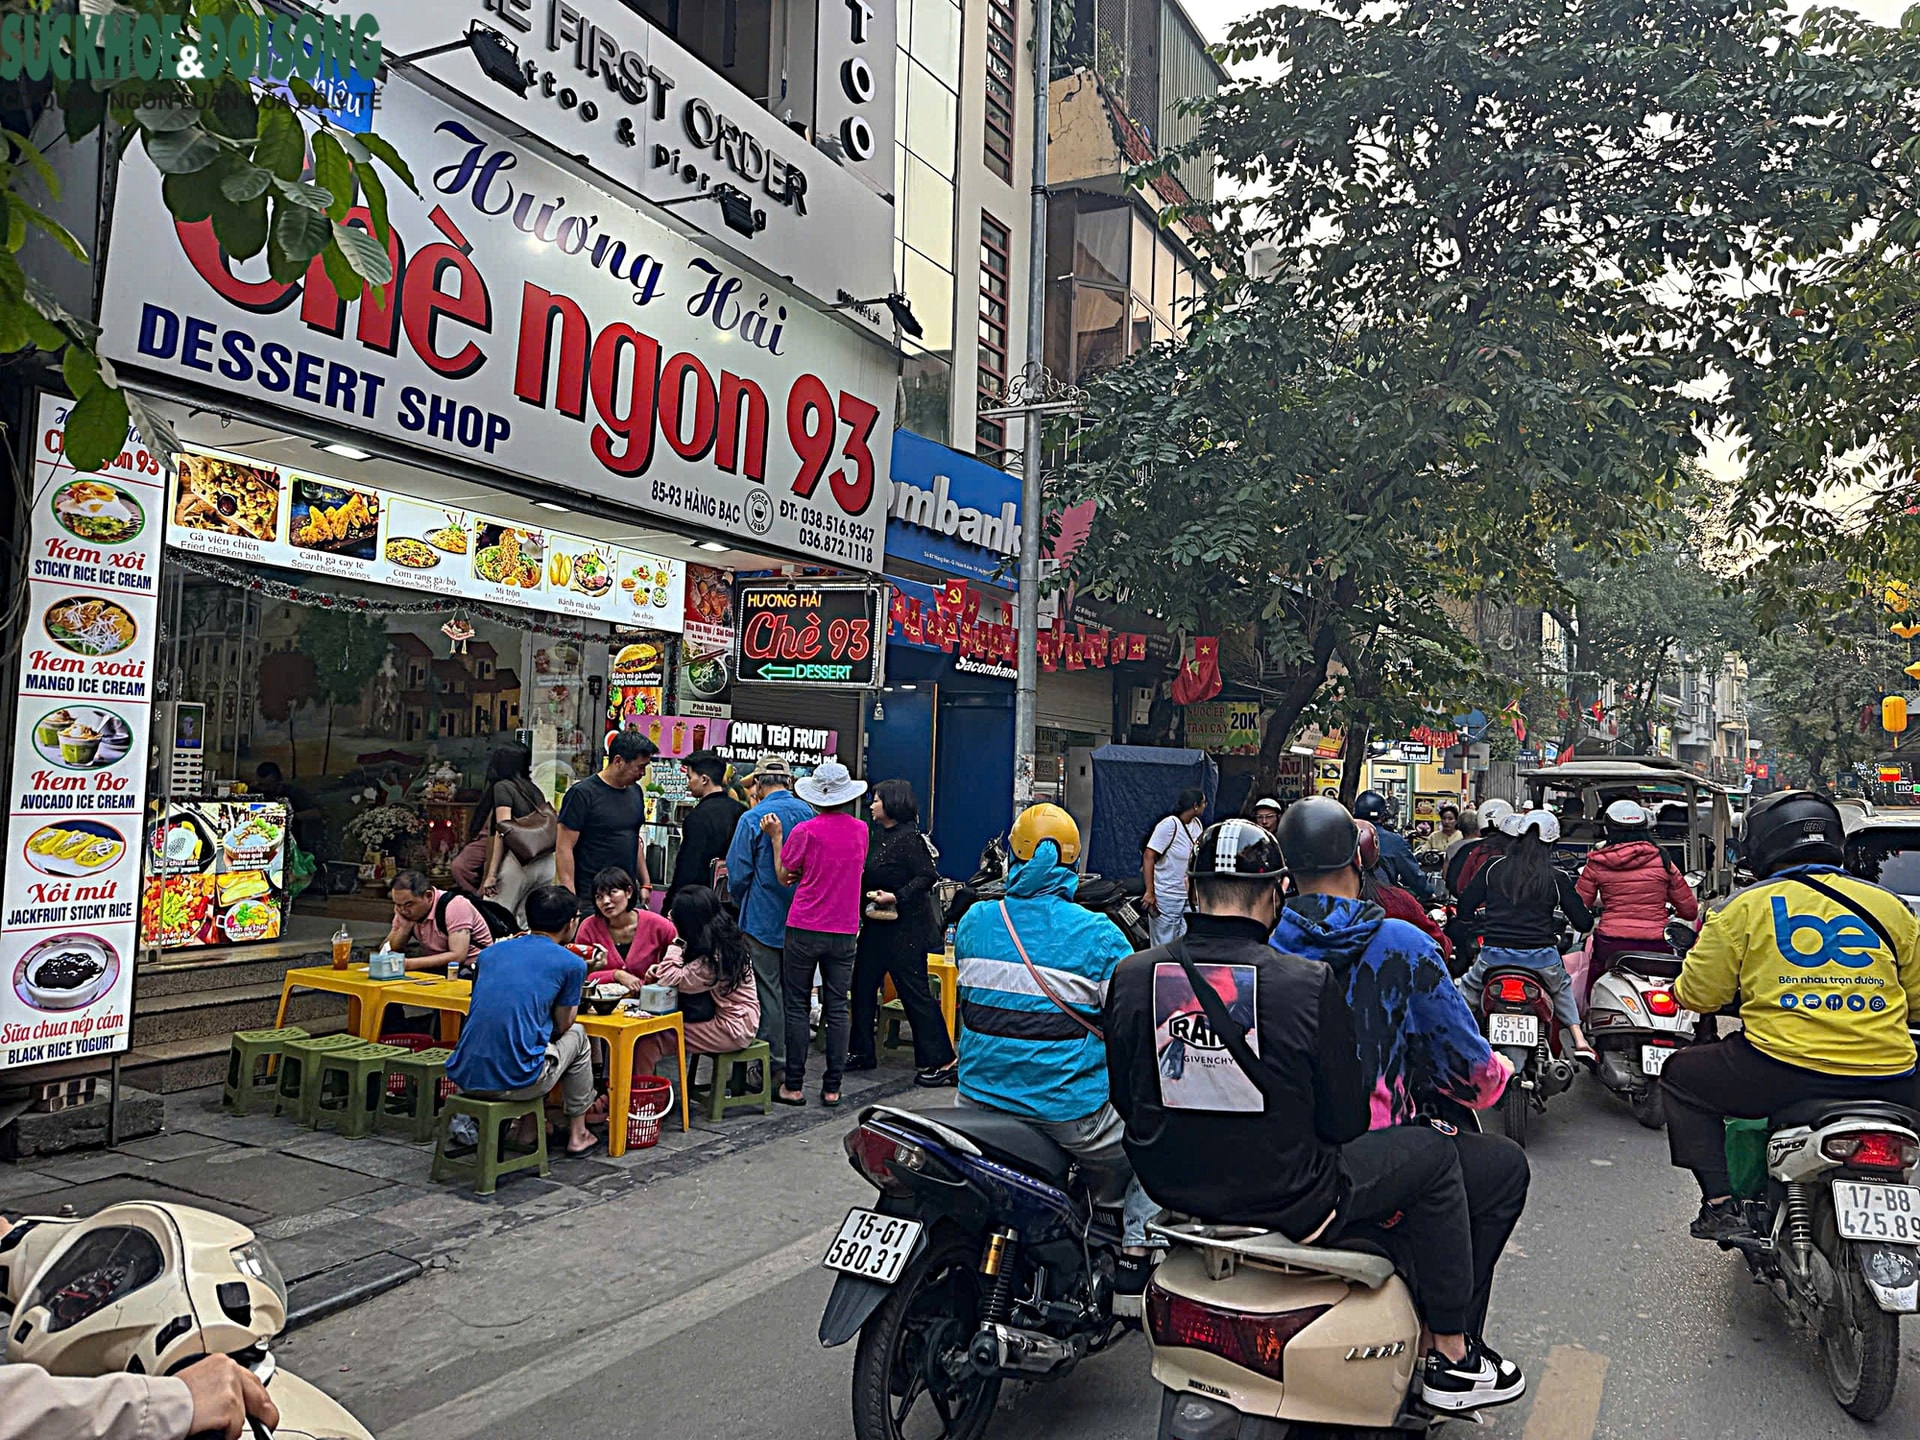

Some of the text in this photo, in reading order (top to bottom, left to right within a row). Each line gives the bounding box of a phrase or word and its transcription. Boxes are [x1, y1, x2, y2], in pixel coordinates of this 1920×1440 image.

[525, 60, 599, 123] ttoo
[617, 117, 637, 148] &
[549, 0, 675, 120] FIRST
[684, 98, 808, 216] ORDER
[433, 120, 785, 356] Hương Hải
[137, 302, 511, 454] DESSERT SHOP
[514, 280, 770, 479] ngon
[786, 373, 881, 516] 93
[652, 479, 742, 528] 85-93 HÀNG BẠC
[780, 499, 876, 545] ĐT: 038.516.9347
[45, 537, 146, 571] Kem xôi
[207, 546, 243, 558] chicken
[245, 552, 266, 562] balls
[799, 528, 874, 565] 036.872.1118
[35, 559, 152, 590] STICKY RICE ICE CREAM
[291, 559, 314, 570] Spicy
[315, 565, 347, 576] chicken
[747, 590, 822, 608] HƯƠNG HẢI
[744, 611, 870, 661] Chè 93
[30, 650, 146, 679] Kem xoài
[795, 663, 853, 680] DESSERT
[26, 674, 146, 697] MANGO ICE CREAM
[1230, 711, 1258, 730] 20K
[731, 722, 828, 750] ANN TEA FRUIT
[716, 745, 734, 760] TRÀ
[736, 746, 756, 761] TRÁI
[31, 770, 86, 791] Kem
[20, 794, 135, 810] AVOCADO ICE CREAM
[27, 879, 118, 904] Xôi mít
[7, 902, 132, 926] JACKFRUIT STICKY RICE
[1770, 896, 1881, 968] be
[1778, 976, 1885, 988] Bên nhau trọn đường
[0, 1005, 124, 1045] Sữa chua nếp cẩm
[1496, 1015, 1530, 1030] 95-E1
[8, 1034, 116, 1065] BLACK RICE YOGURT
[1493, 1030, 1534, 1044] 461.00
[1183, 1055, 1234, 1065] GIVENCHY
[1849, 1186, 1911, 1212] 17-B8
[852, 1213, 909, 1248] 15-G1
[829, 1238, 902, 1279] 580.31
